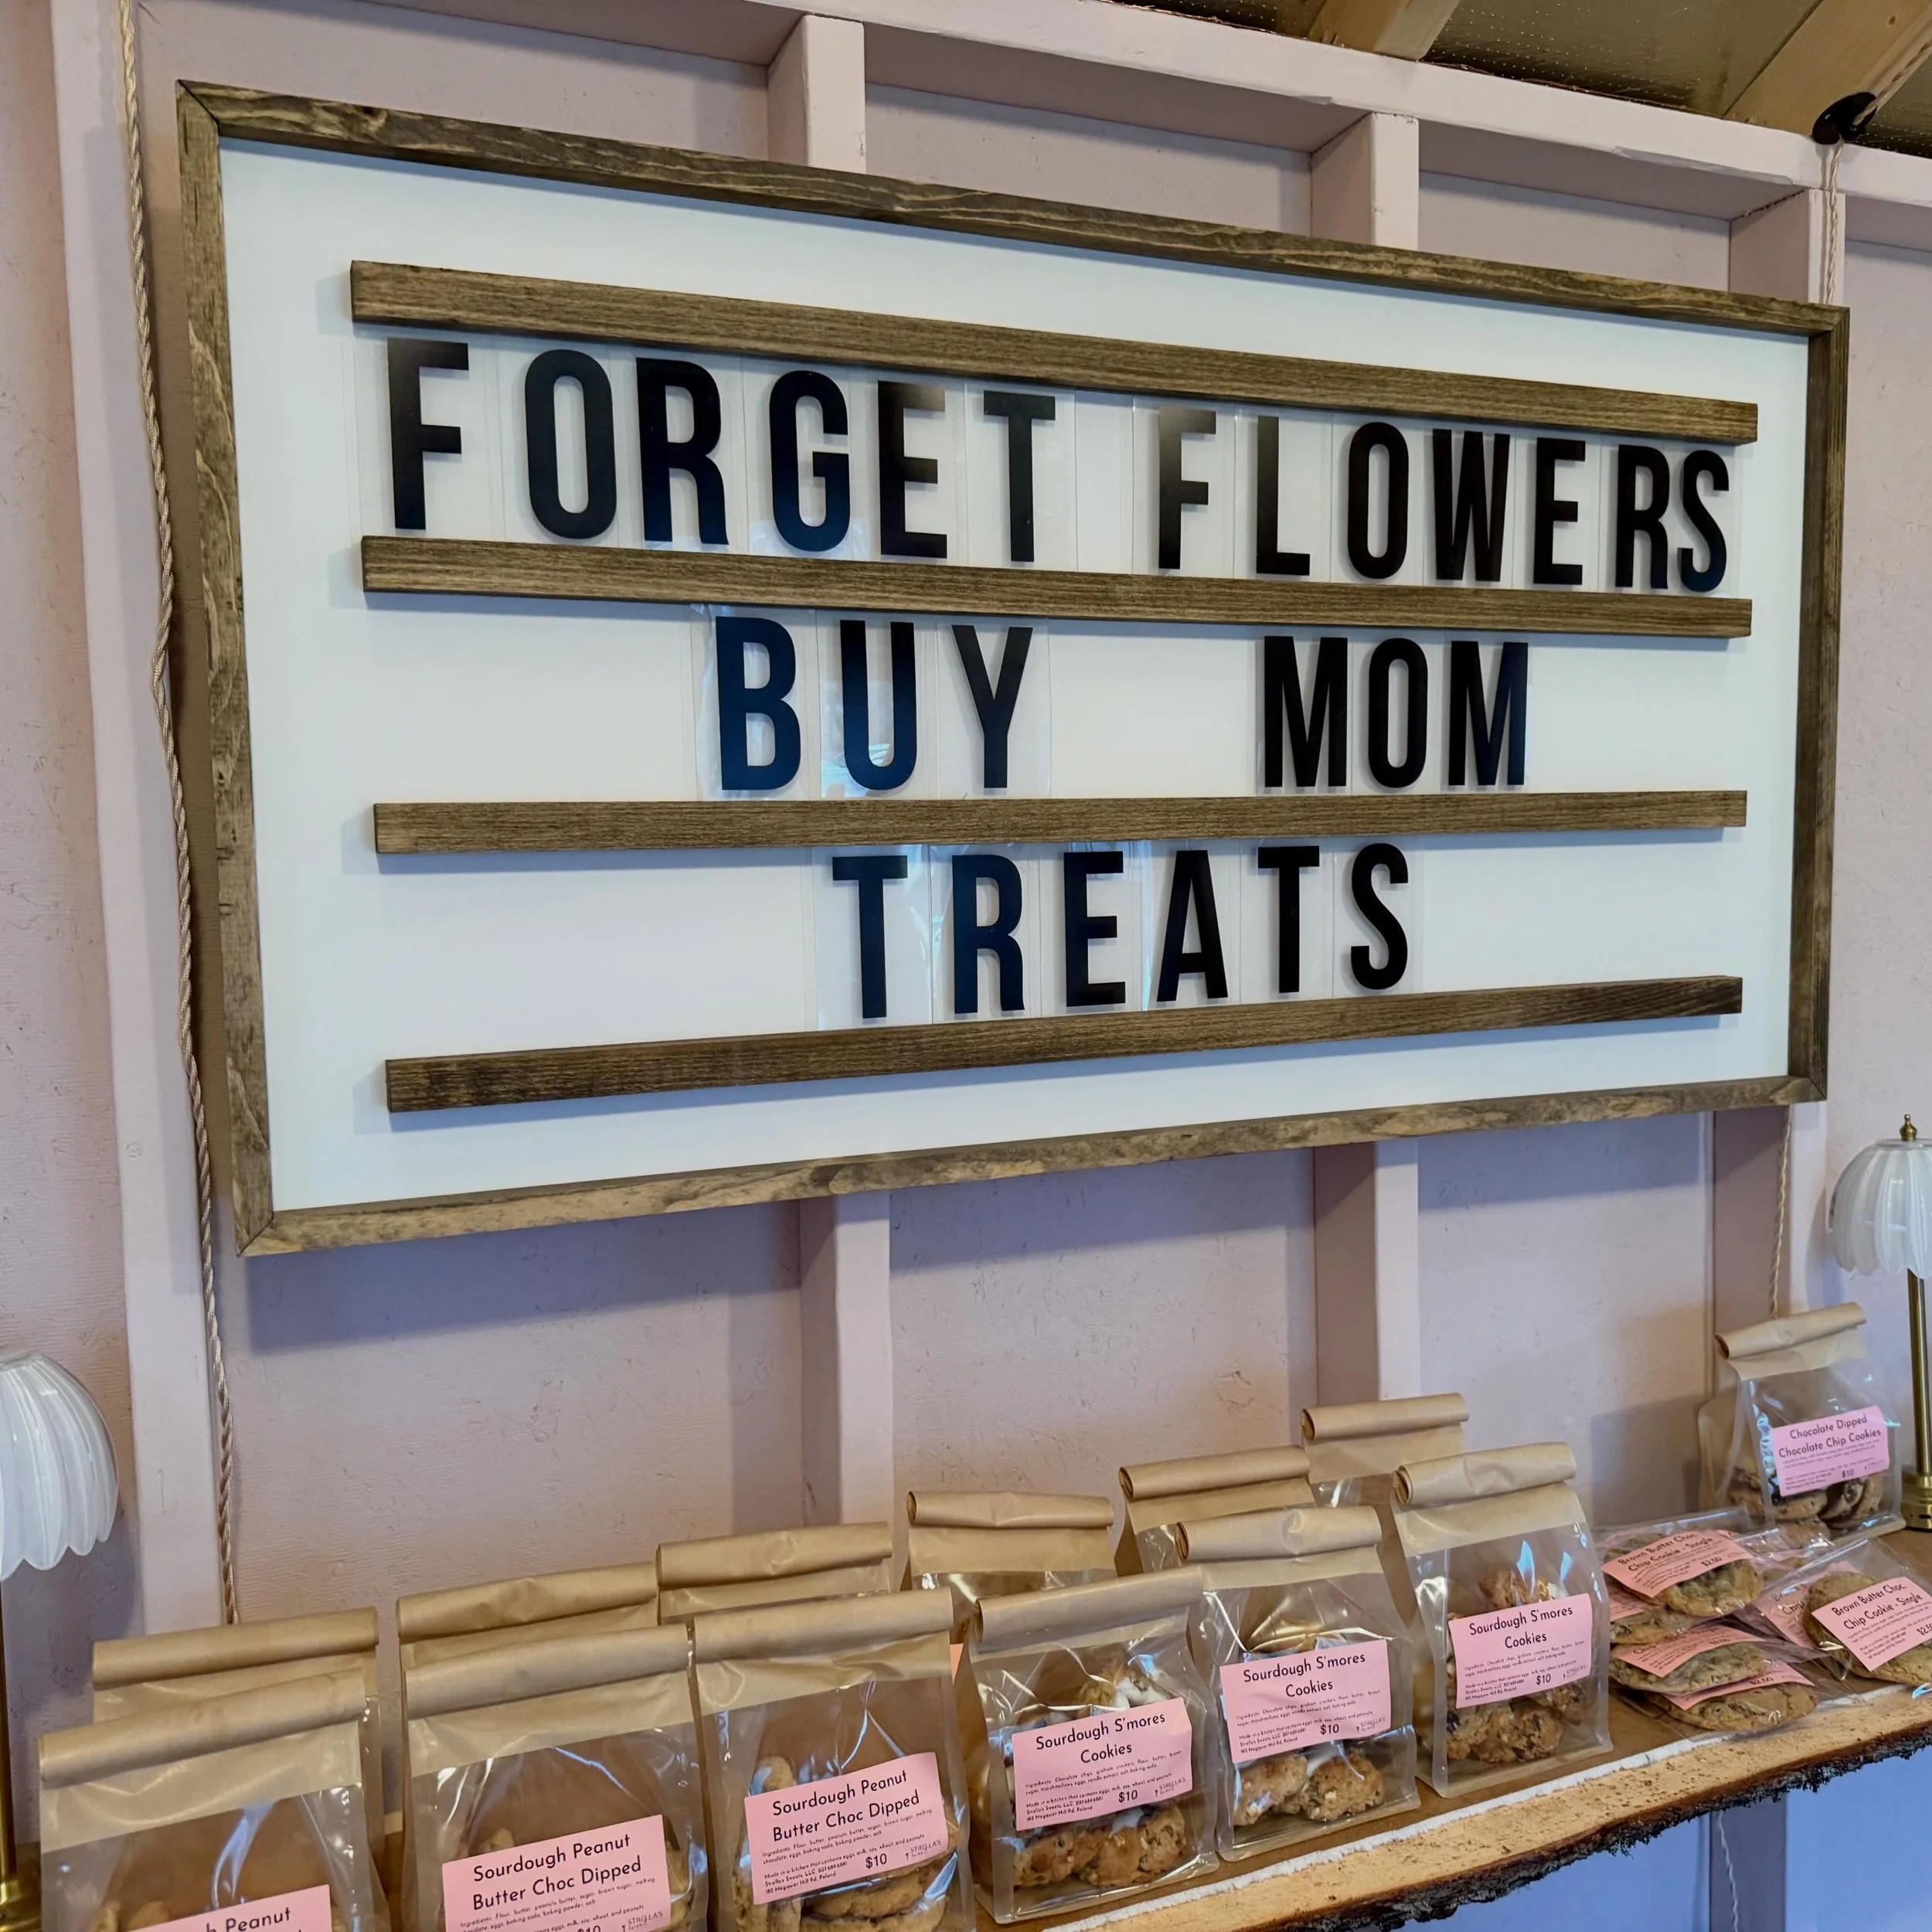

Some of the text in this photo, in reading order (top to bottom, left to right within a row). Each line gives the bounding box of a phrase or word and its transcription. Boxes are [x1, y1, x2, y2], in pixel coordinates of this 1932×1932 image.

[388, 338, 1729, 592] FORGET FLOWERS
[716, 616, 1529, 791] BUY MOM
[832, 843, 1409, 1019] TREATS
[1789, 1413, 1867, 1440] Chocolate Dipped
[1778, 1442, 1823, 1458] Chocolate
[1825, 1436, 1847, 1447] Chip
[1848, 1428, 1881, 1442] Cookies
[1842, 1468, 1854, 1478] $10
[1618, 1550, 1647, 1565] Brown
[1646, 1541, 1674, 1554] Butter
[1628, 1559, 1651, 1572] Chip
[1651, 1548, 1682, 1562] Cookie
[1832, 1600, 1860, 1617] Brown
[1857, 1590, 1885, 1605] Butter
[1843, 1617, 1867, 1630] Chip
[1864, 1604, 1894, 1620] Cookie
[1896, 1592, 1923, 1606] Single
[1468, 1607, 1573, 1635] Sourdough S'mores
[1504, 1631, 1547, 1649] Cookies
[1243, 1654, 1366, 1682] Sourdough S'mores
[1536, 1673, 1551, 1685] $10
[1285, 1679, 1333, 1697] Cookies
[1036, 1713, 1165, 1750] Sourdough S'mores
[1320, 1723, 1339, 1736] $10
[1080, 1743, 1132, 1764] Cookies
[772, 1769, 906, 1816] Sourdough Peanut
[1118, 1789, 1138, 1804] $10
[773, 1788, 920, 1842] Butter Choc Dipped
[473, 1833, 630, 1882] Sourdough Peanut
[865, 1852, 887, 1869] $10
[473, 1854, 641, 1910] Butter Choc Dipped
[804, 1868, 815, 1877] LLC
[226, 1906, 291, 1932] Peanut
[611, 1908, 622, 1917] and
